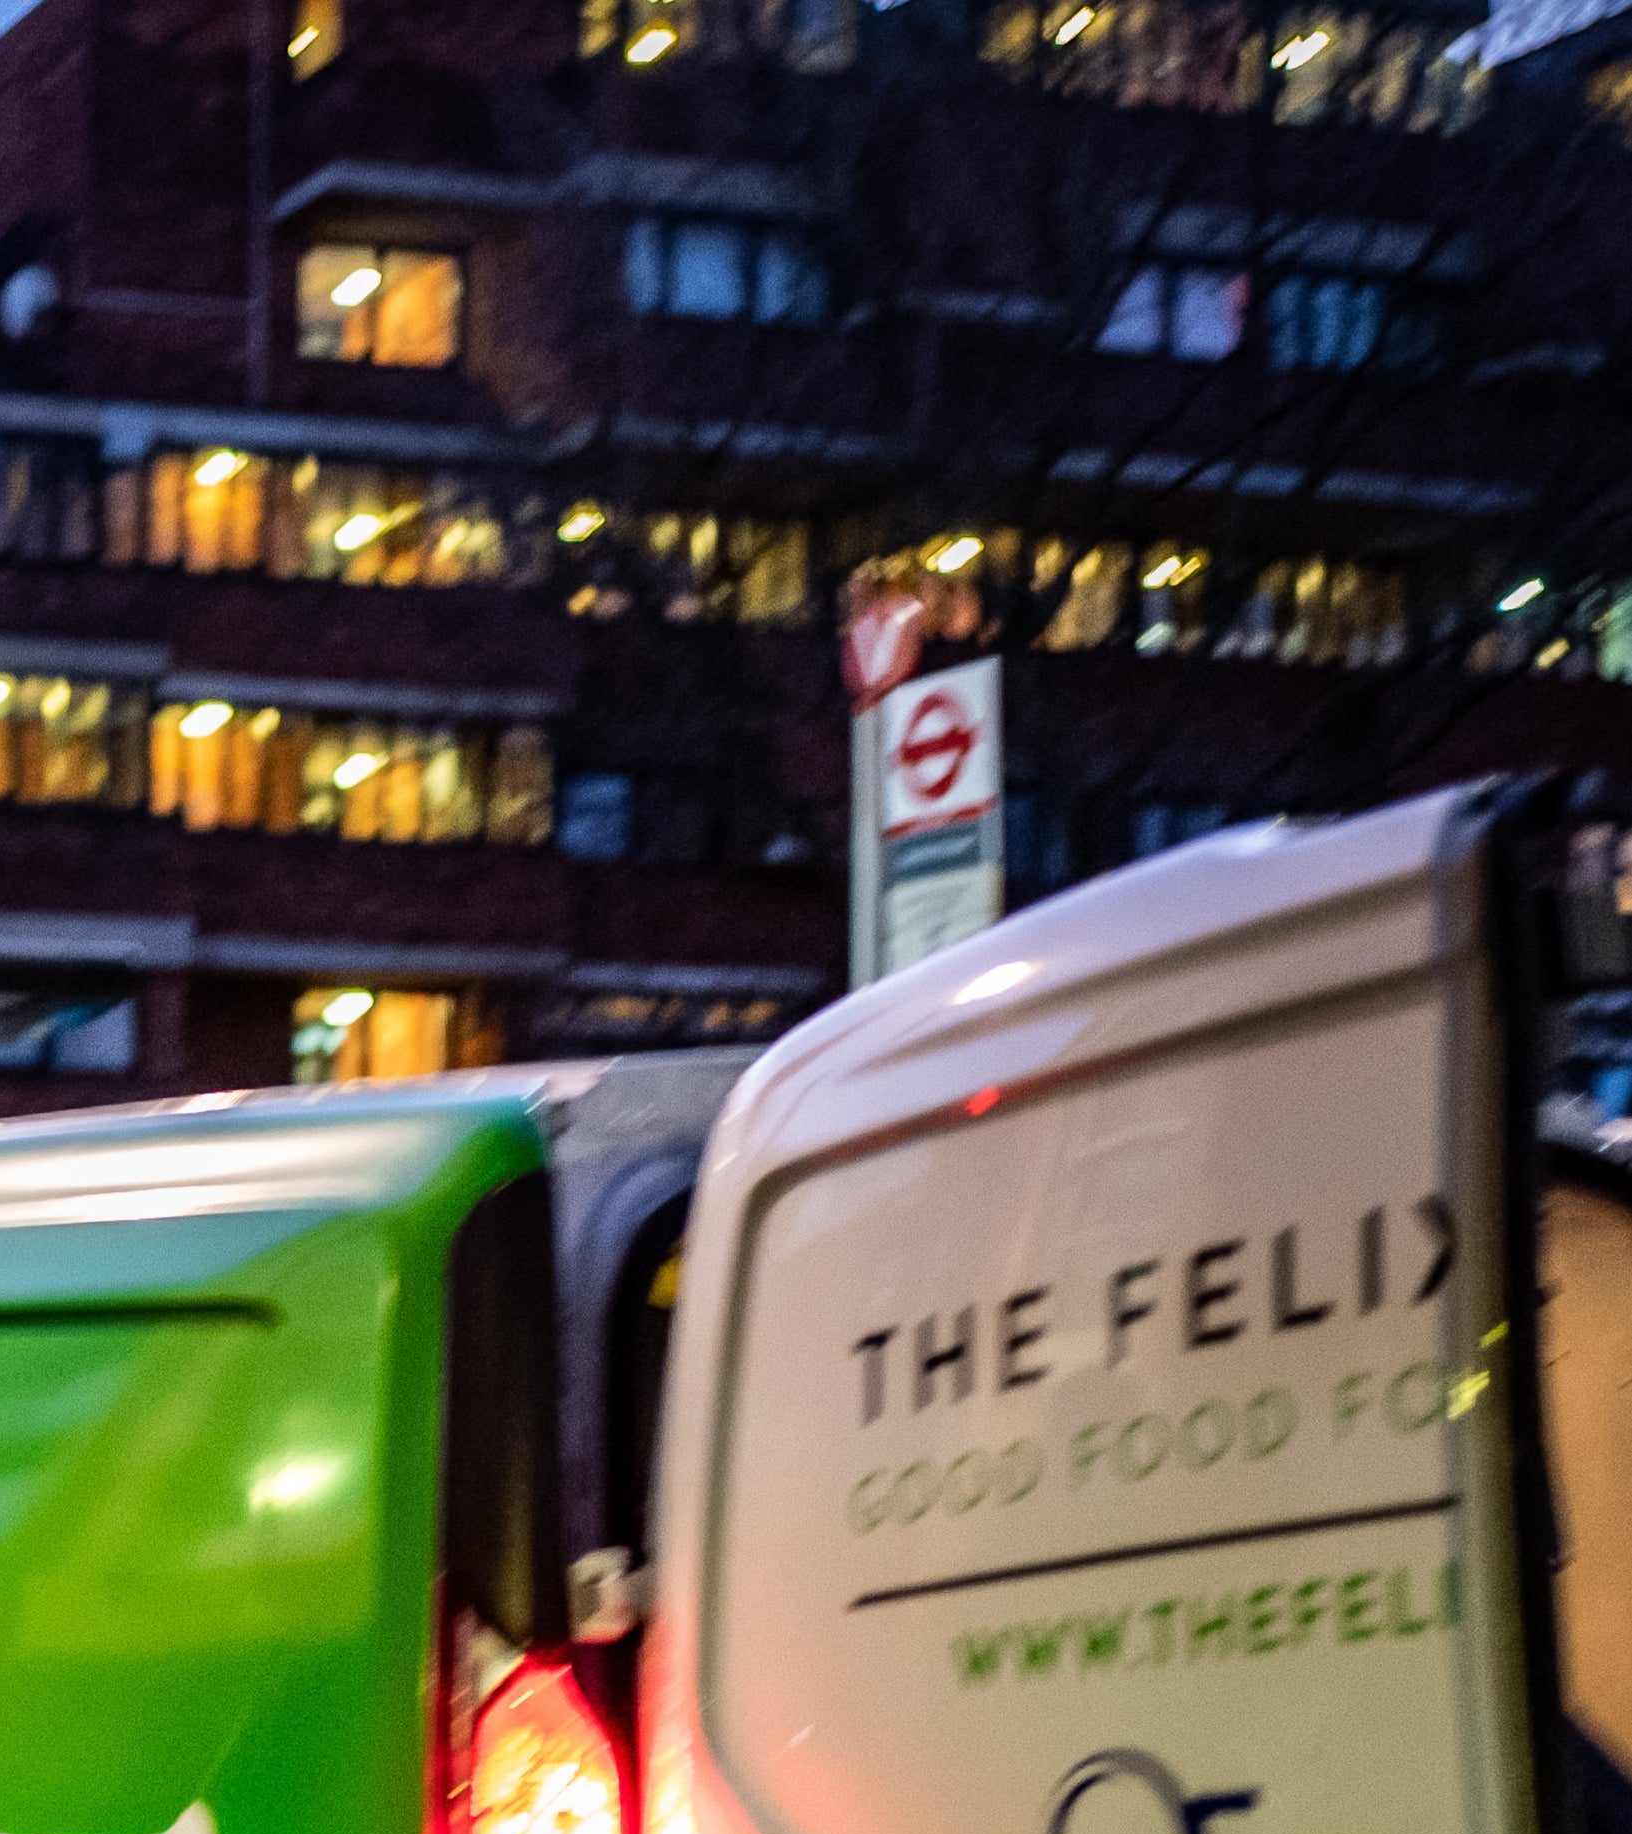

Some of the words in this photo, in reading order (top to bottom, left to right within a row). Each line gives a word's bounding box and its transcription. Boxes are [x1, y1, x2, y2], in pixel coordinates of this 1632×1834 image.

[851, 1282, 1053, 1430] THE
[851, 1438, 1043, 1537] GOOD
[1067, 1385, 1298, 1490] FOOD
[1335, 1357, 1463, 1440] FO
